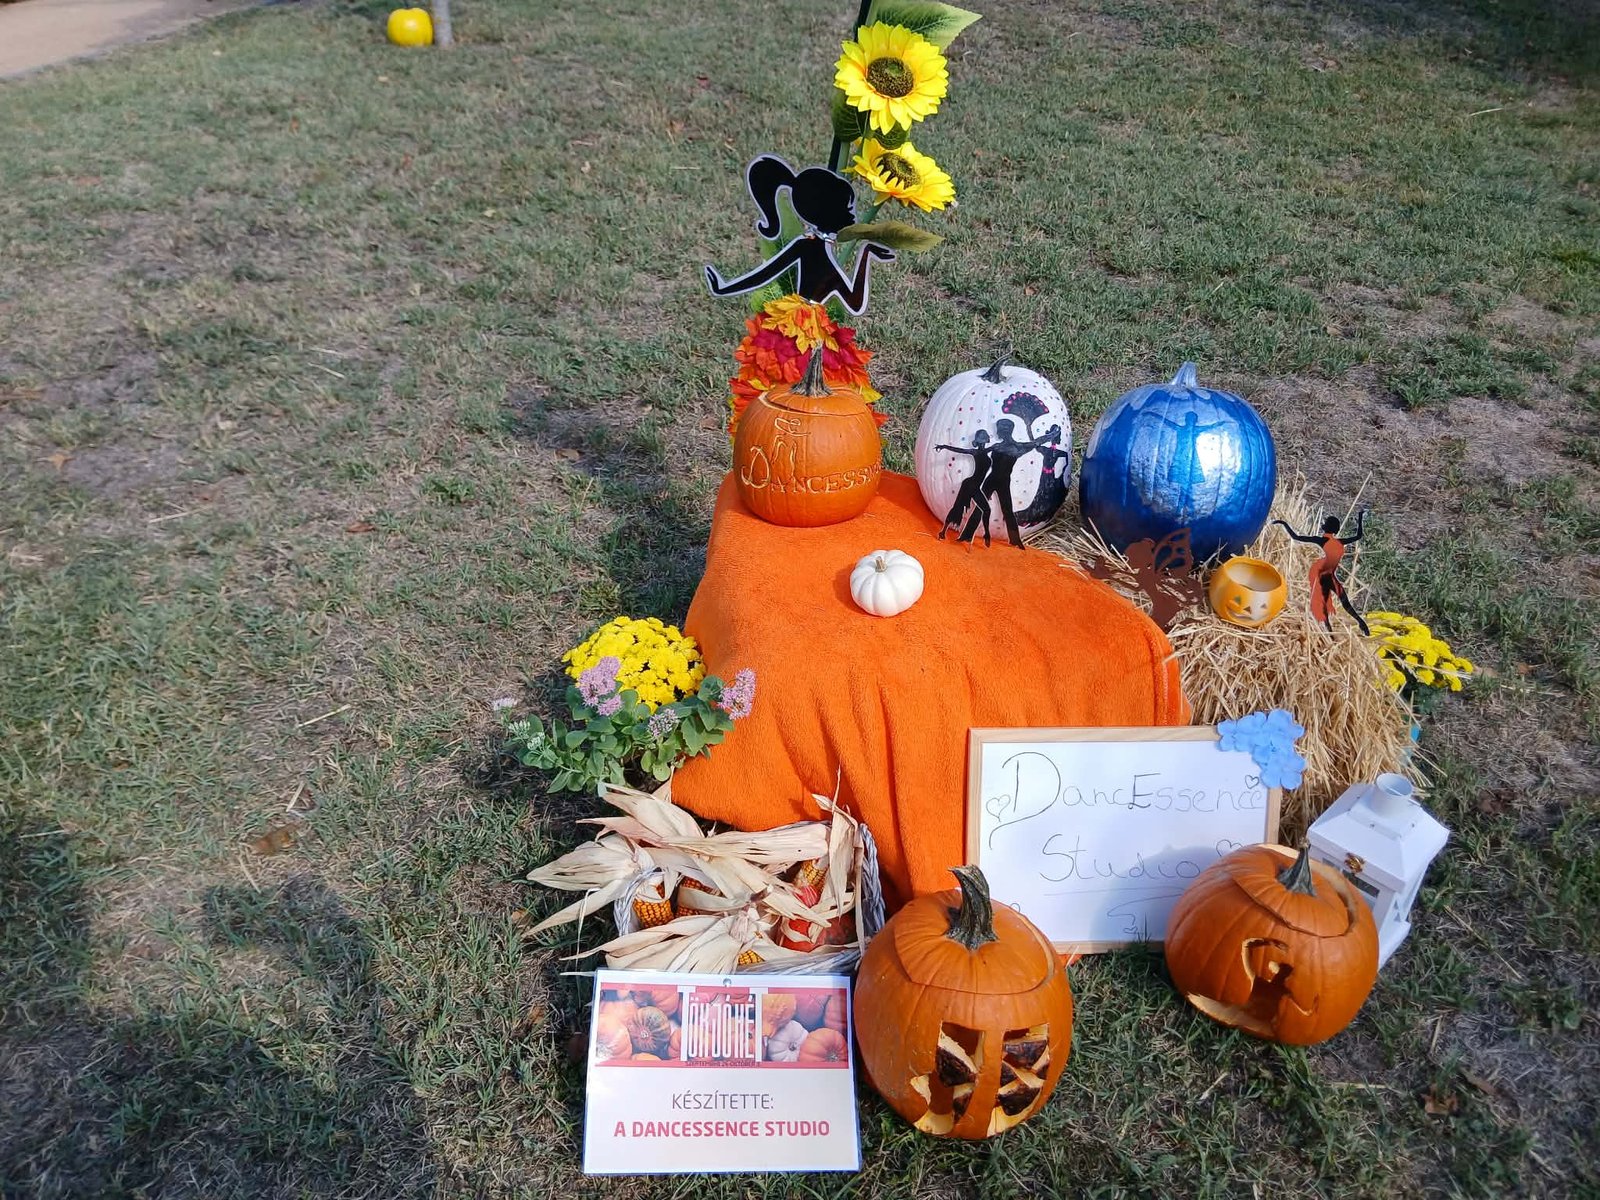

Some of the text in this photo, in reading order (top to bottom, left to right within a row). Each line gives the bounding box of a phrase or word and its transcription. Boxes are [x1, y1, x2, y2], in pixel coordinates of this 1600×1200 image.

[1039, 833, 1201, 882] Studio
[672, 1090, 774, 1110] KÉSZÍTETTE:
[613, 1120, 831, 1138] A DANCESSENCE STUDIO
